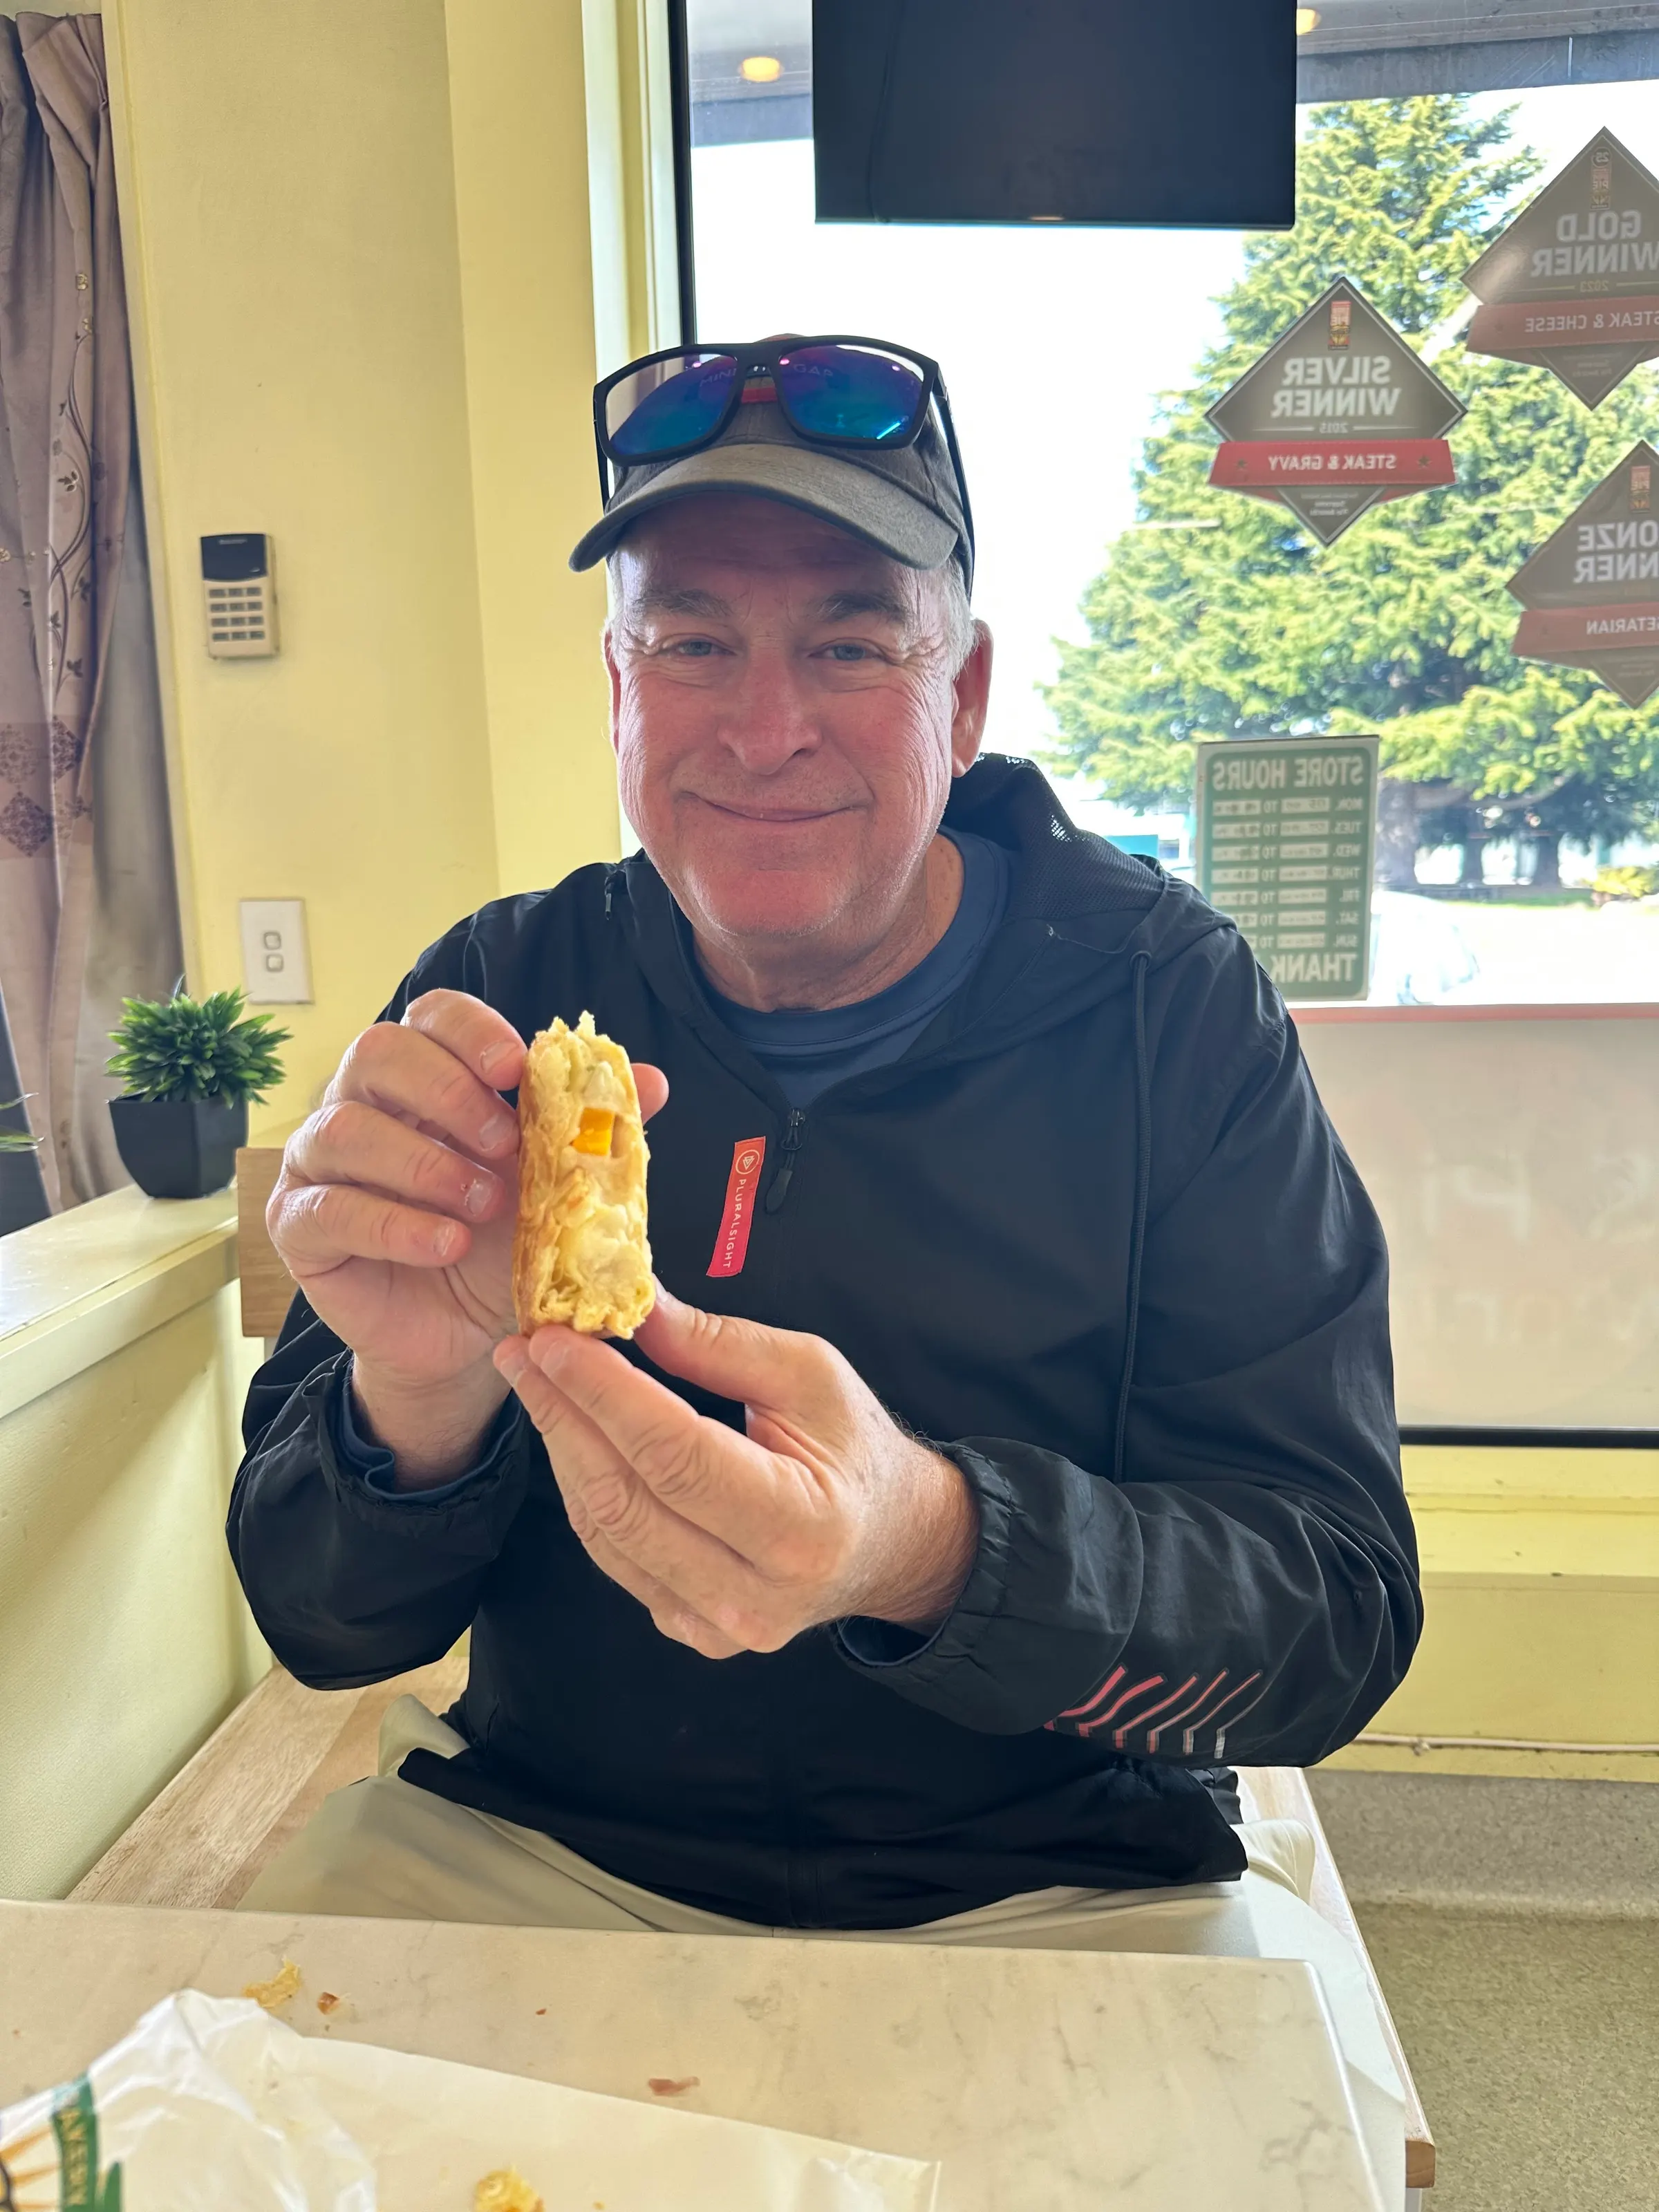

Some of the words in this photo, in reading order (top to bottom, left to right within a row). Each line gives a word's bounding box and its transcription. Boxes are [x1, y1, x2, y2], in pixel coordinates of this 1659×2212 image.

[700, 368, 737, 388] MIN
[794, 364, 834, 377] GAP
[723, 1178, 747, 1268] PLURALSIGHT
